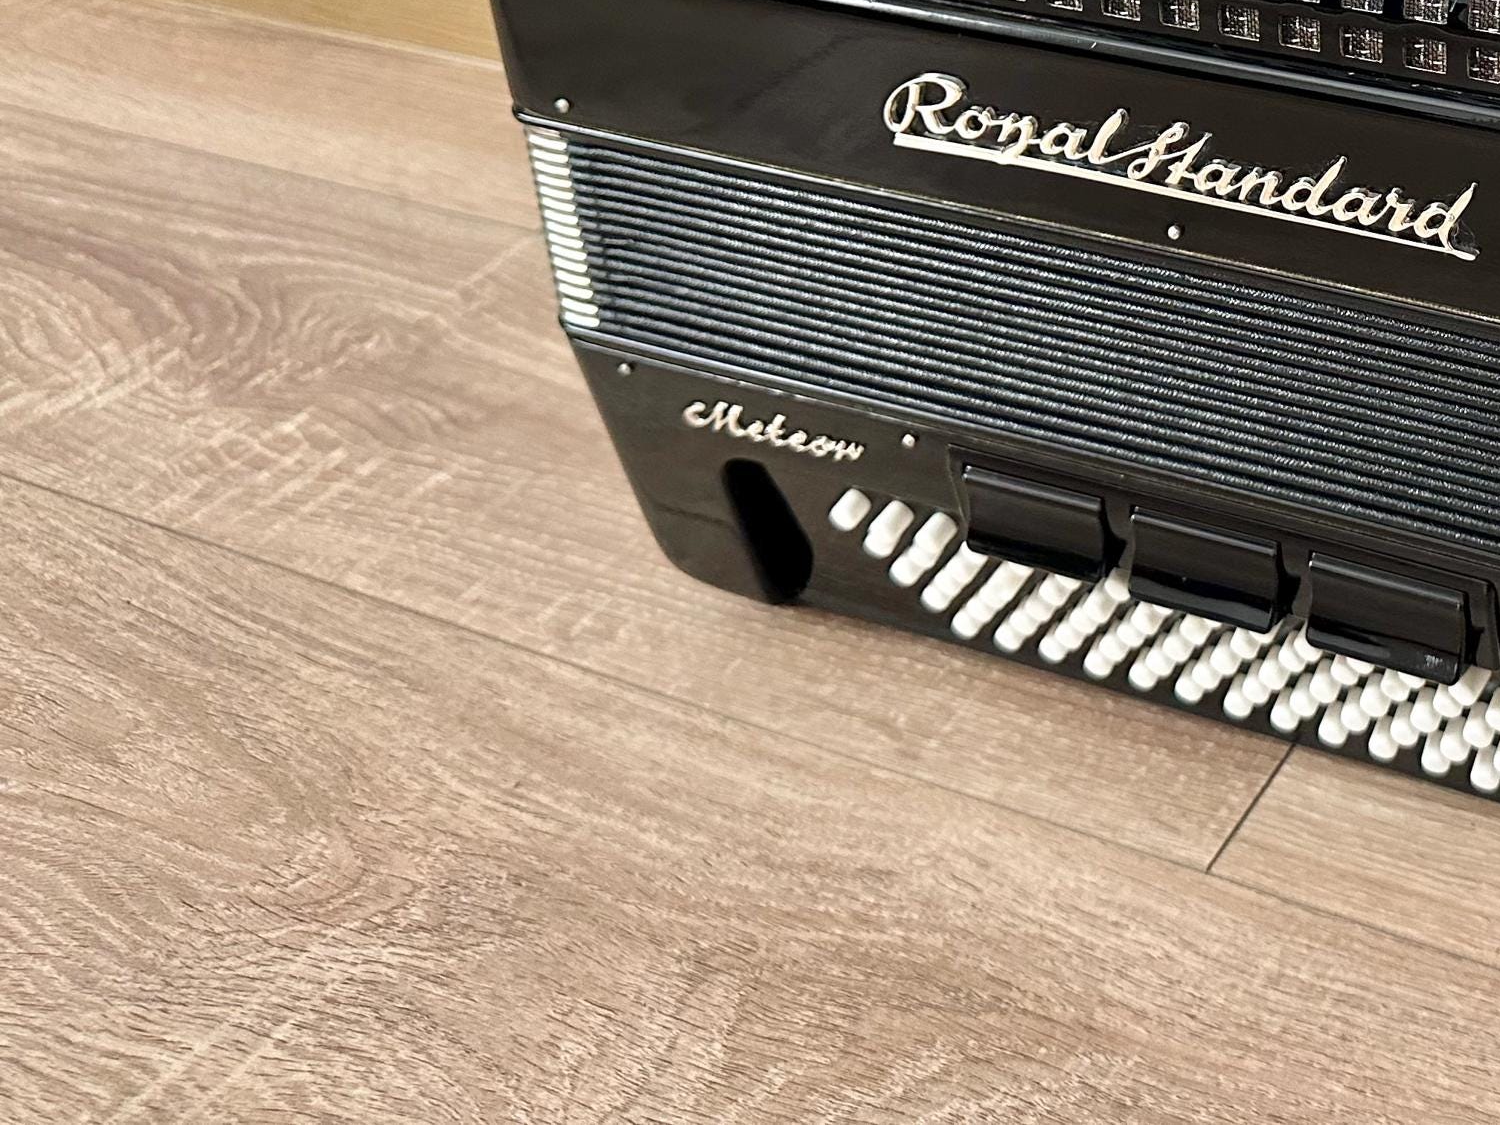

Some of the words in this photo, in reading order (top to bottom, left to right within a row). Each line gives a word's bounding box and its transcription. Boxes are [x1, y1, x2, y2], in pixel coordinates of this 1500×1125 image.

[882, 73, 1130, 164] Royal
[1126, 121, 1479, 254] Standard
[682, 401, 865, 462] Meteor
